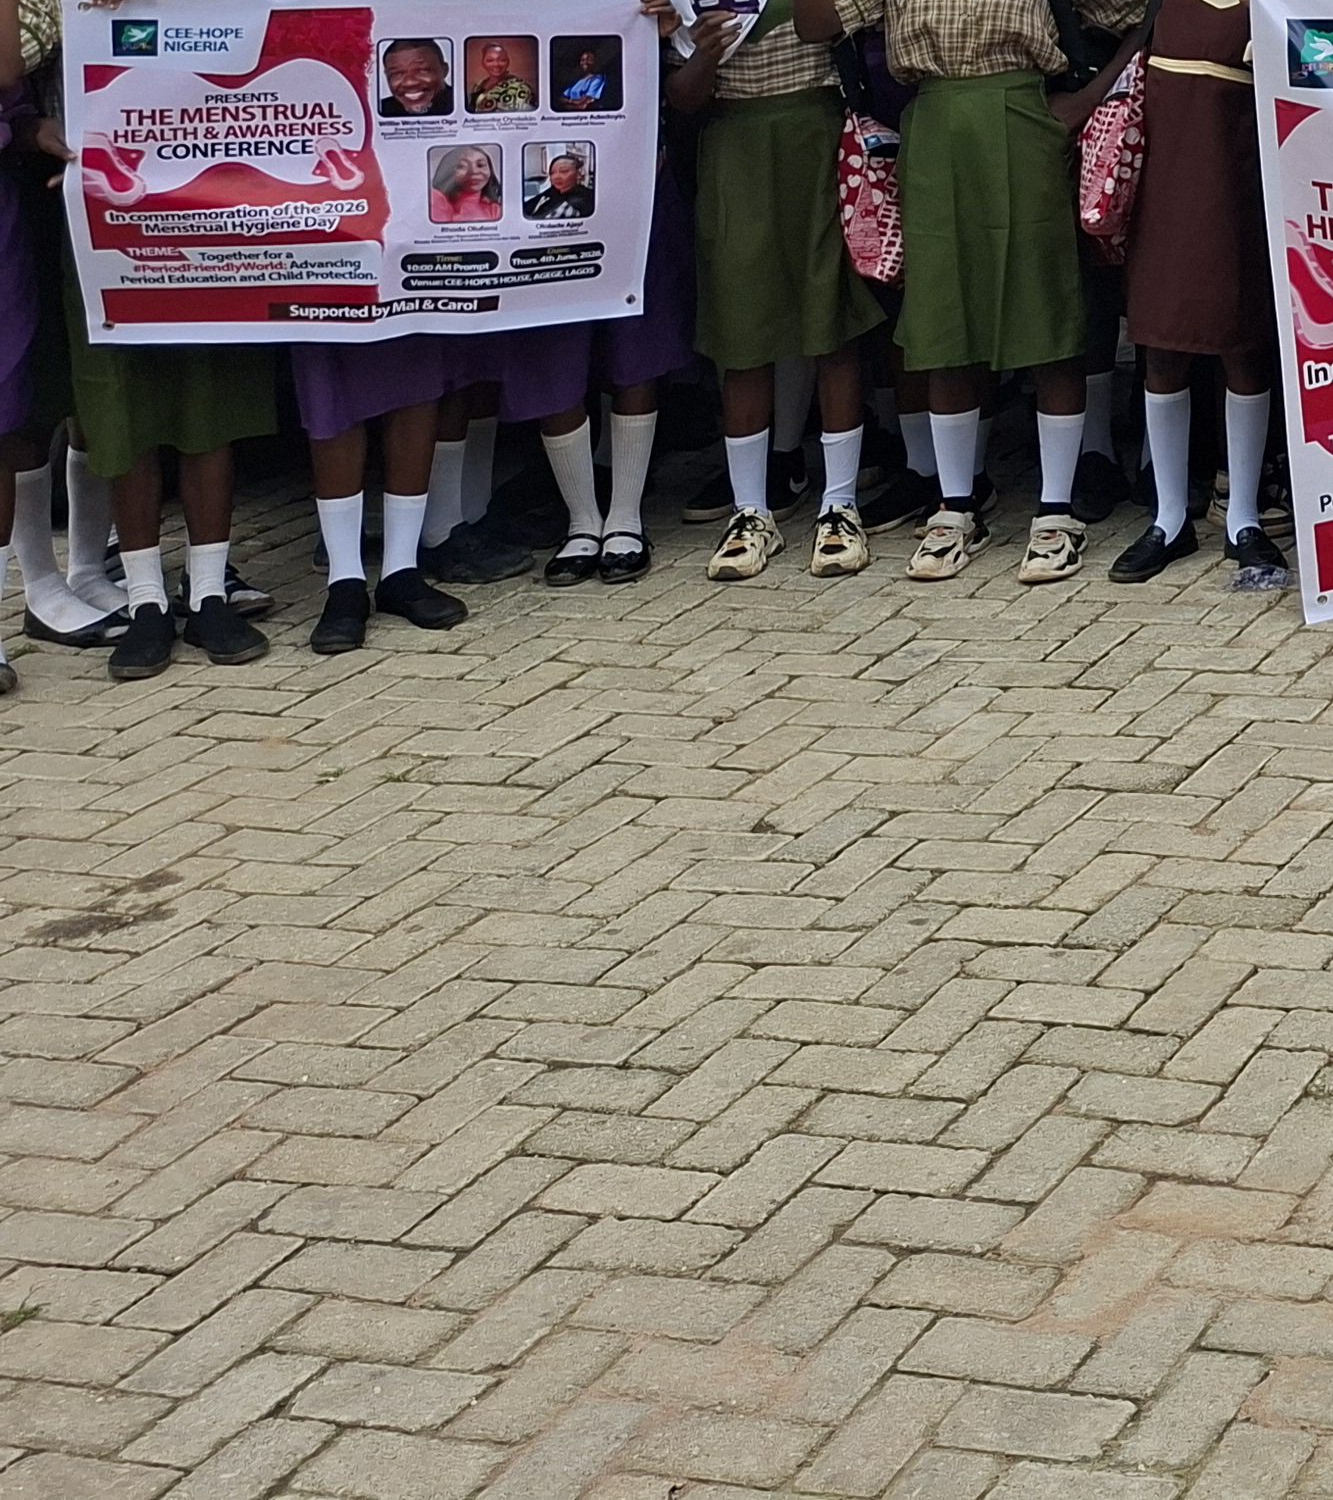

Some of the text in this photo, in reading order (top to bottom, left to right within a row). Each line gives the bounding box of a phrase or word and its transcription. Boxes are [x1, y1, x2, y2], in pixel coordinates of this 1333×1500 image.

[163, 27, 244, 40] CEE-HOPE
[163, 41, 229, 52] NIGERIA
[204, 92, 279, 105] PRESENTS
[120, 102, 342, 127] THE MENSTRUAL
[113, 121, 354, 144] HEALTH & AWARENESS
[156, 139, 314, 160] CONFERENCE
[108, 201, 366, 224] In commemoration the 2026
[144, 216, 338, 234] Menstrual Hygiene Day
[199, 250, 282, 263] Together for
[290, 258, 362, 272] Advancing
[120, 268, 378, 284] Period Education and Child Protection.
[410, 278, 443, 288] Venue:
[289, 298, 478, 320] Supported by Mal & Carol
[1306, 364, 1329, 386] In
